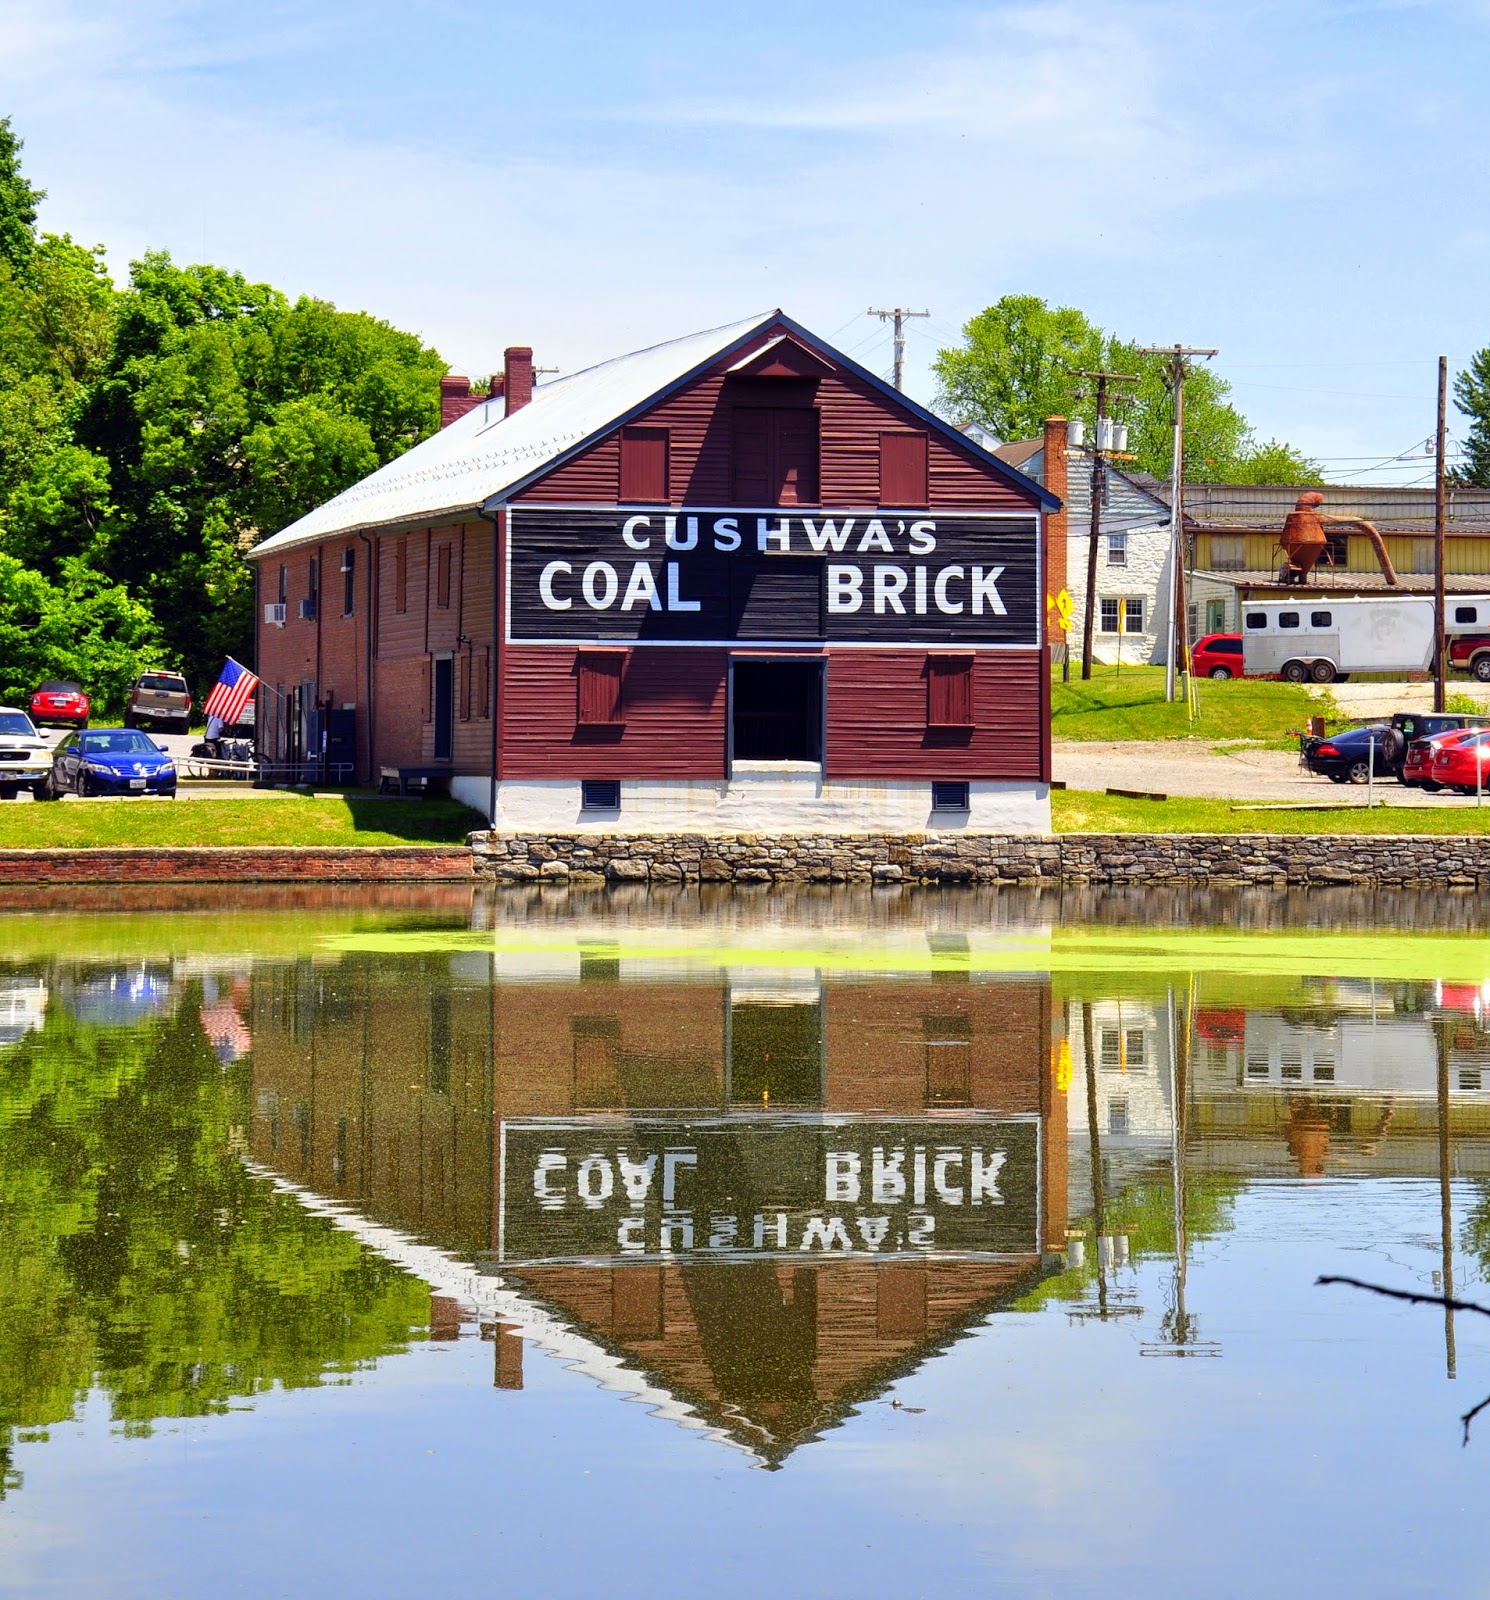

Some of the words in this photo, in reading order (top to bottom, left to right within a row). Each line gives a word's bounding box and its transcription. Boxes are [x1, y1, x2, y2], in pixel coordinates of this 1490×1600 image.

[622, 514, 937, 555] CUSHWA'S
[538, 560, 701, 612] COAL
[826, 564, 1008, 616] BRICK
